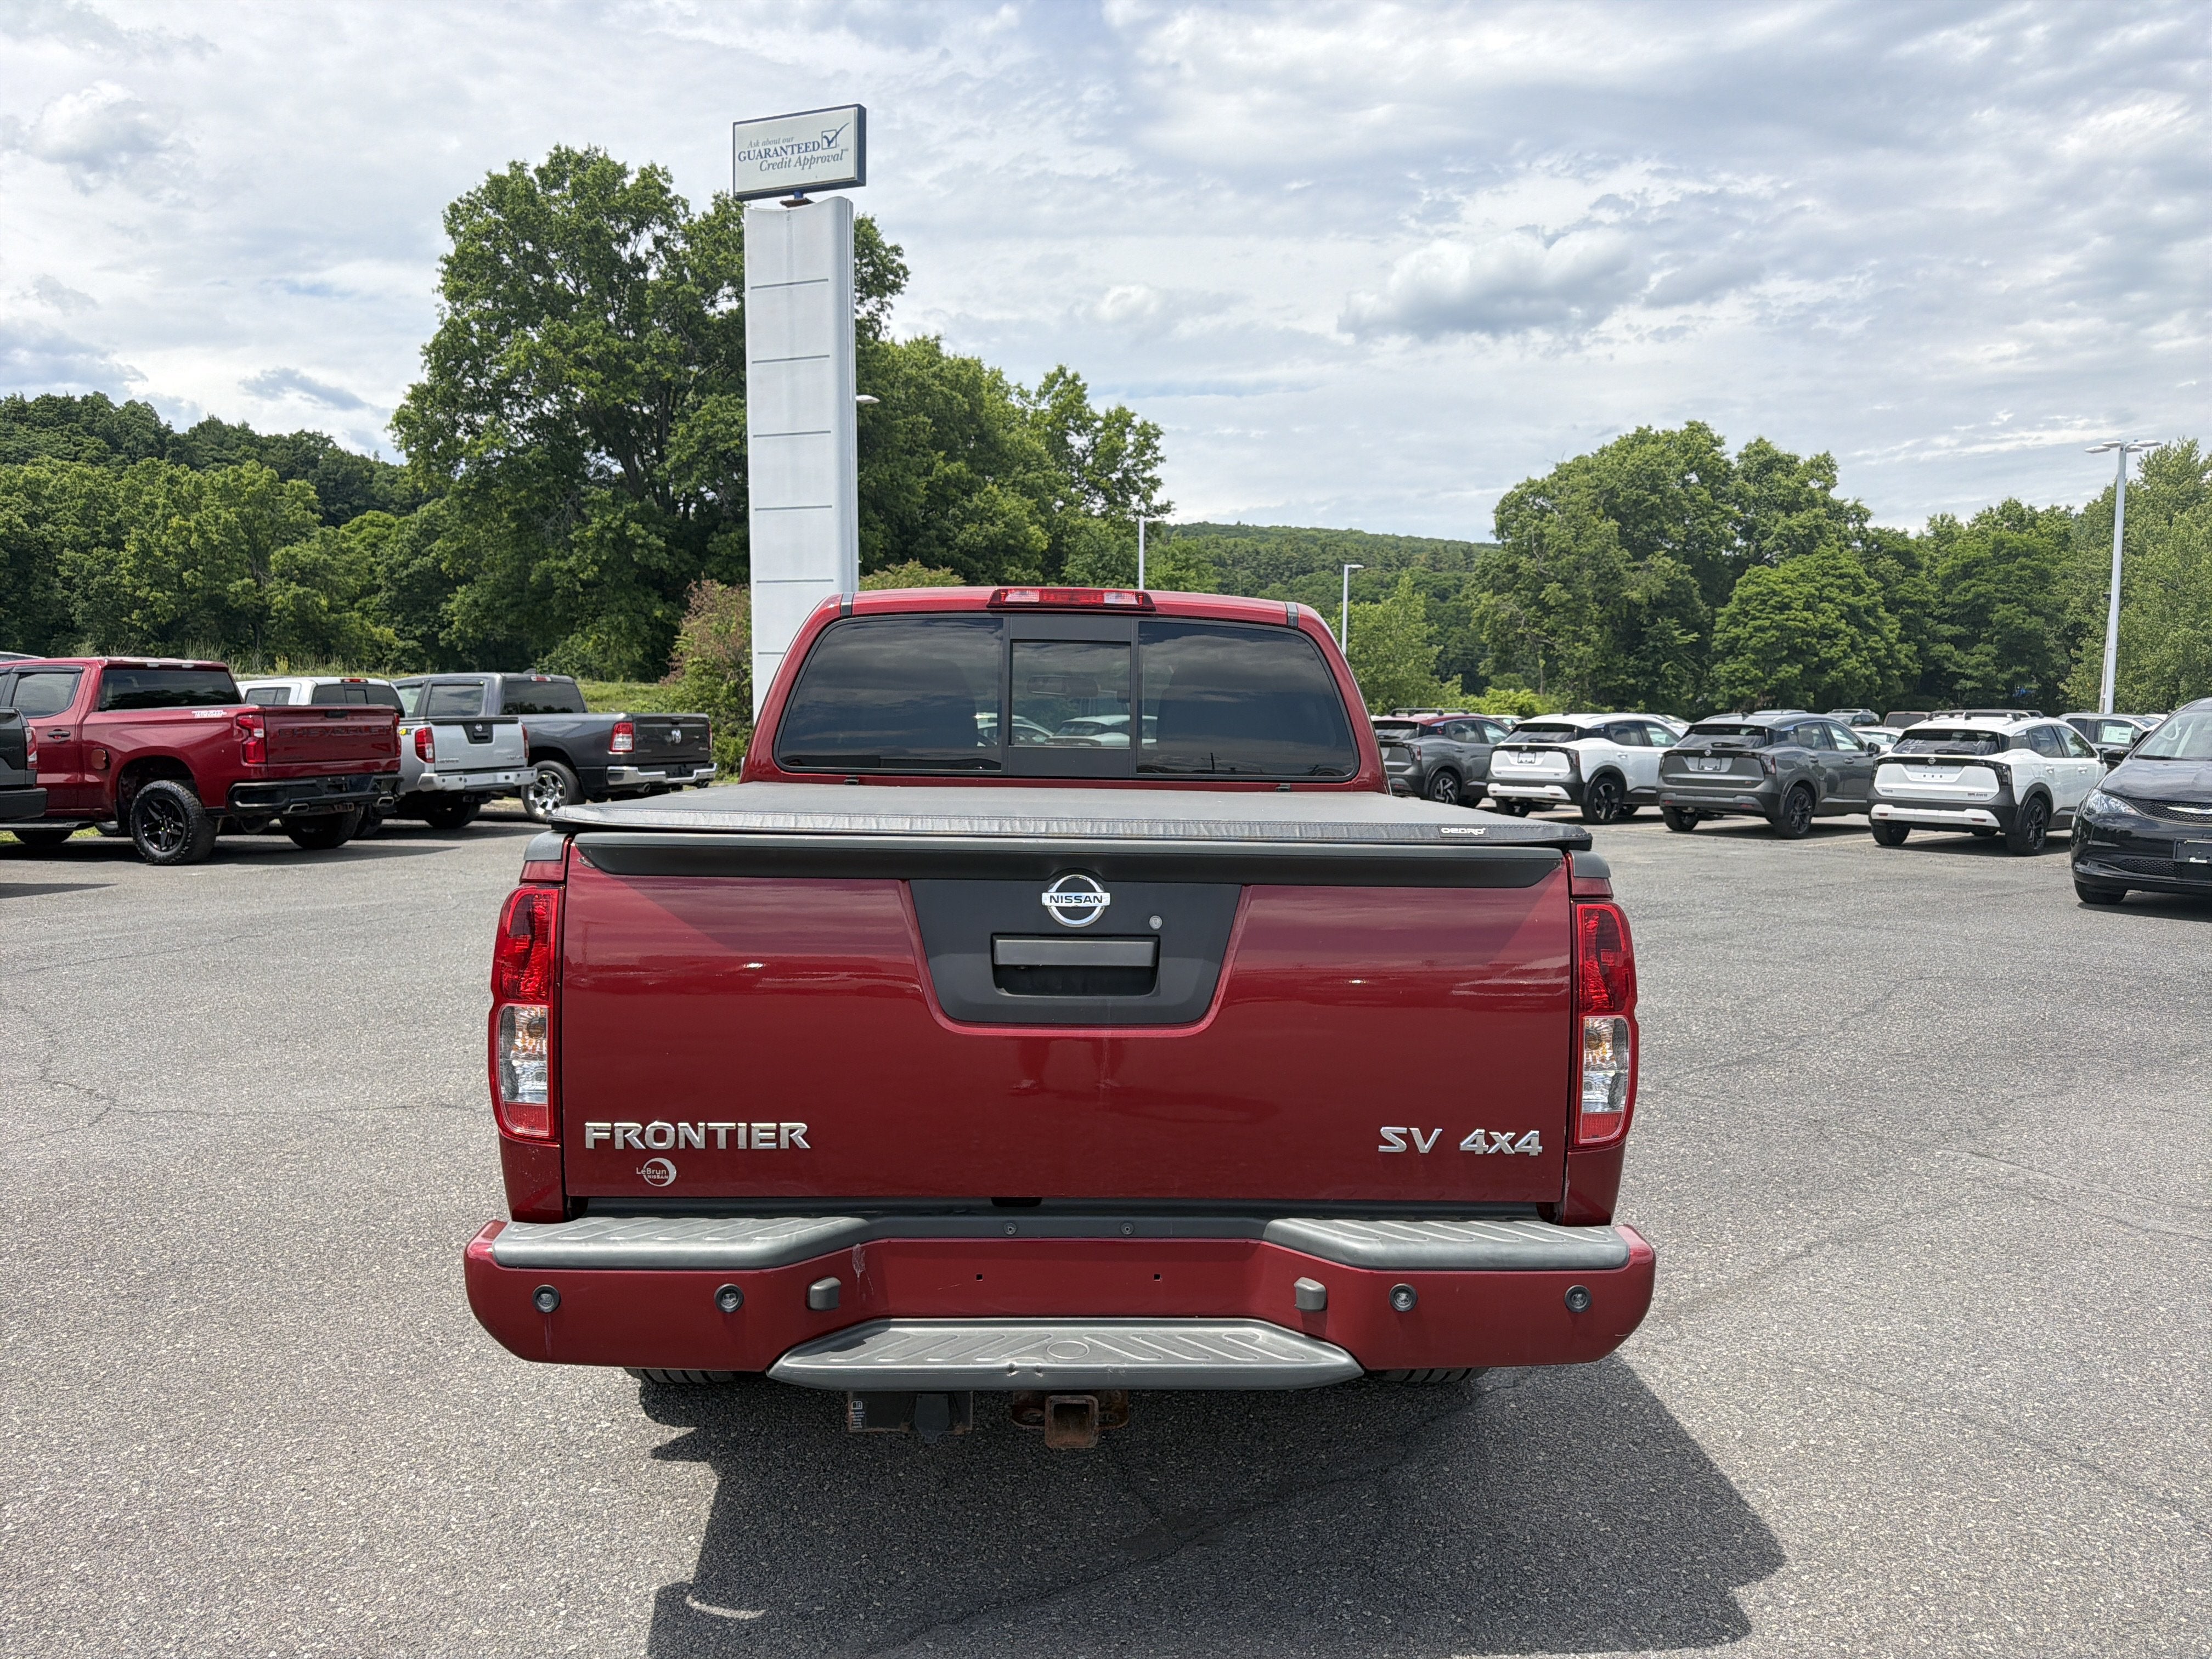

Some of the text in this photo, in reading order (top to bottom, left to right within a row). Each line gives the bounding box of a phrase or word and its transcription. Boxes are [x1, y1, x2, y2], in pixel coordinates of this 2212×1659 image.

[738, 141, 820, 162] GUARANTEED
[747, 139, 760, 149] Ask
[761, 137, 781, 147] about
[759, 149, 844, 172] Credit Approval
[1049, 895, 1103, 904] NISSAN
[585, 1121, 811, 1150] FRONTIER
[1378, 1126, 1443, 1154] SV
